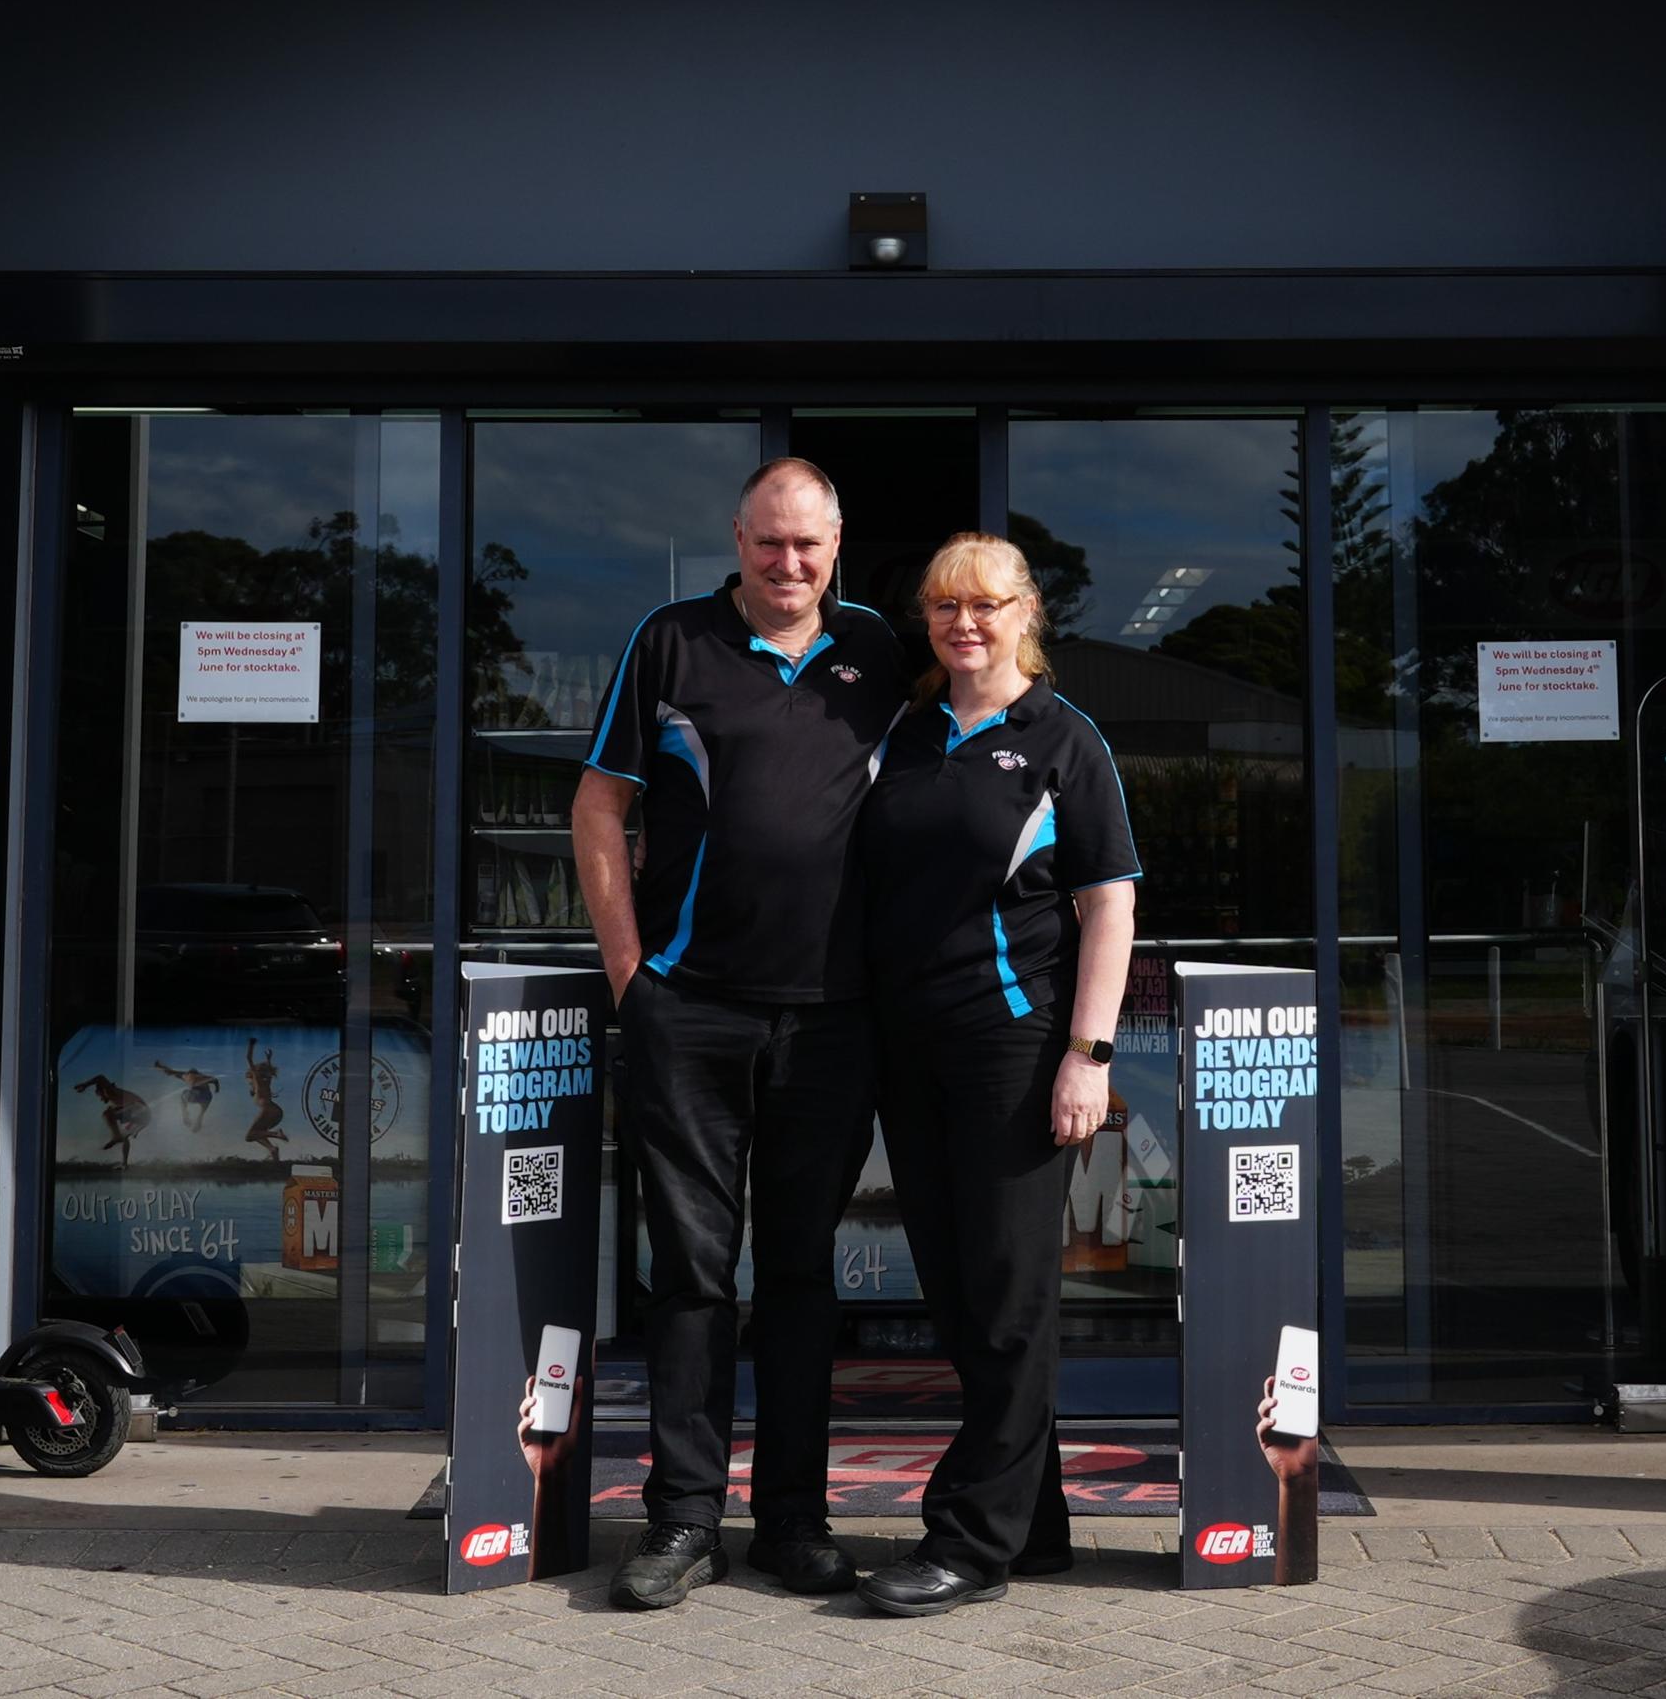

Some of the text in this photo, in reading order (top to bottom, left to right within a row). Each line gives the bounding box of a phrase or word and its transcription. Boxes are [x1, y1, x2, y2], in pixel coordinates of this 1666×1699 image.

[196, 631, 213, 639] We
[216, 631, 234, 639] will
[237, 631, 250, 639] be
[253, 631, 292, 642] closing
[198, 647, 221, 658] 5pm
[224, 647, 286, 658] Wednesday
[1493, 650, 1602, 660] We will be closing at
[198, 663, 300, 672] June for stocktake.
[1495, 667, 1519, 677] 5pm
[1522, 666, 1585, 676] Wednesday
[1497, 681, 1598, 691] June for stocktake.
[992, 750, 1012, 759] PINK
[478, 1007, 588, 1042] JOIN OUR
[1195, 1008, 1261, 1038] JOIN
[479, 1038, 591, 1072] REWARDS
[477, 1067, 593, 1103] PROGRAM
[476, 1101, 554, 1134] TODAY
[1195, 1099, 1285, 1130] TODAY
[62, 1190, 111, 1224] OUT
[143, 1188, 201, 1221] PLAY
[200, 1218, 240, 1262] '64
[842, 1244, 888, 1292] '64
[539, 1378, 570, 1391] Rewards
[1279, 1379, 1317, 1394] Rewards
[1253, 1524, 1268, 1533] YOU
[465, 1530, 510, 1559] IGA
[1201, 1529, 1251, 1556] IGA
